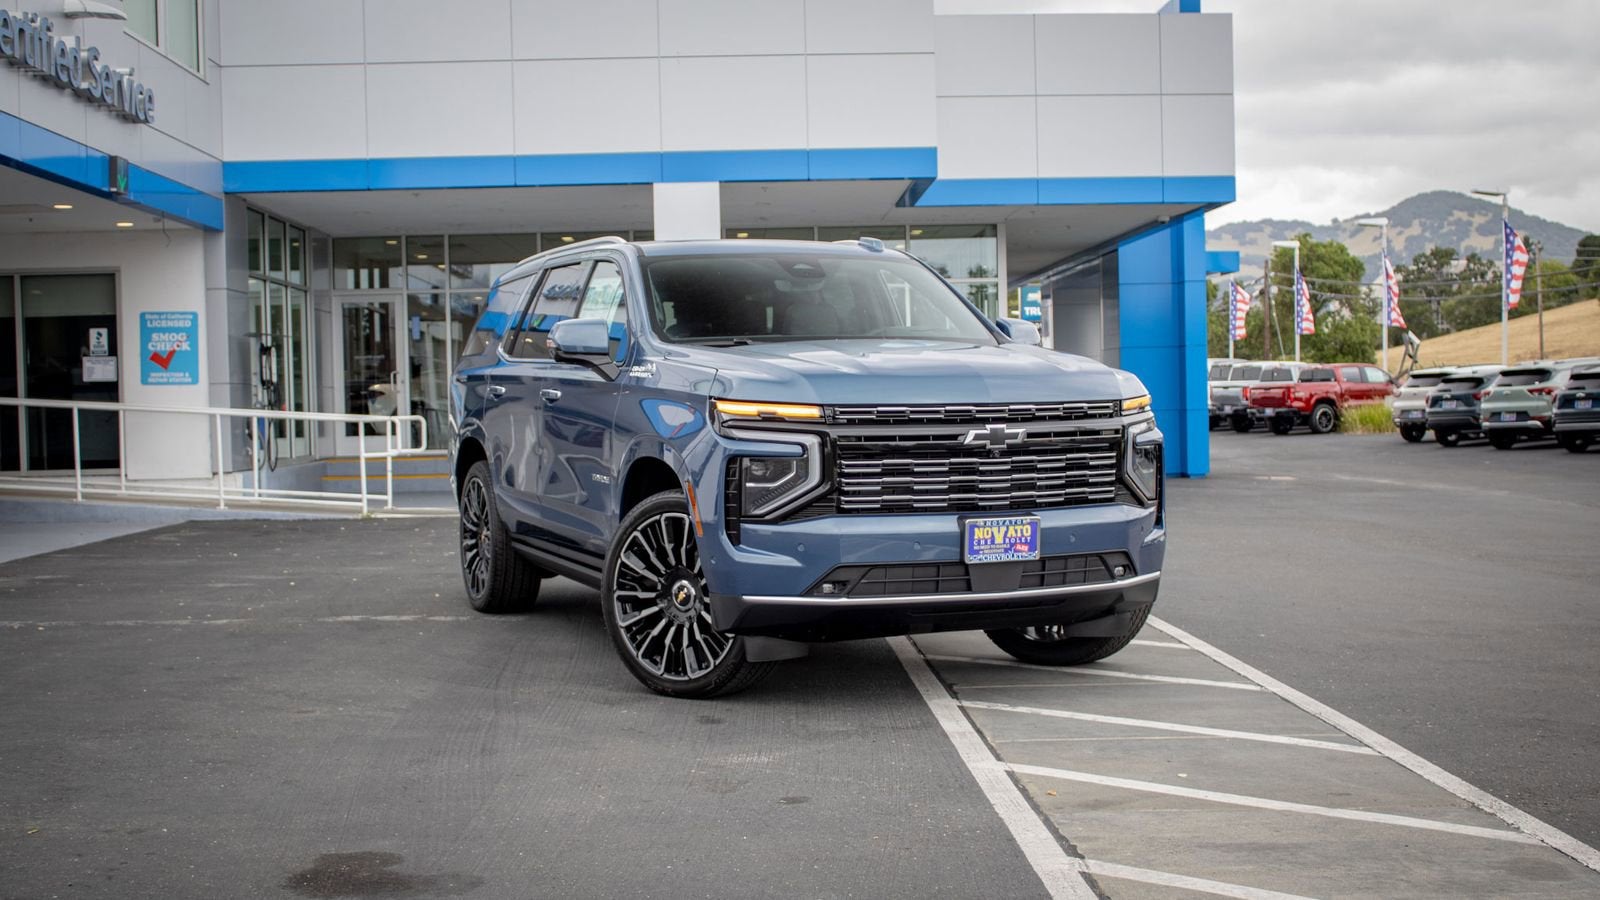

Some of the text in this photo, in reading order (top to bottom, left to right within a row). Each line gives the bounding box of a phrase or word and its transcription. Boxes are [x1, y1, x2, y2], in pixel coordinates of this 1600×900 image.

[87, 46, 155, 123] Service
[147, 320, 192, 328] LICENSED
[152, 333, 187, 342] SMOG
[148, 341, 191, 351] CHECK
[974, 525, 1031, 544] NOVATO
[983, 553, 1022, 561] CHEVROLET
